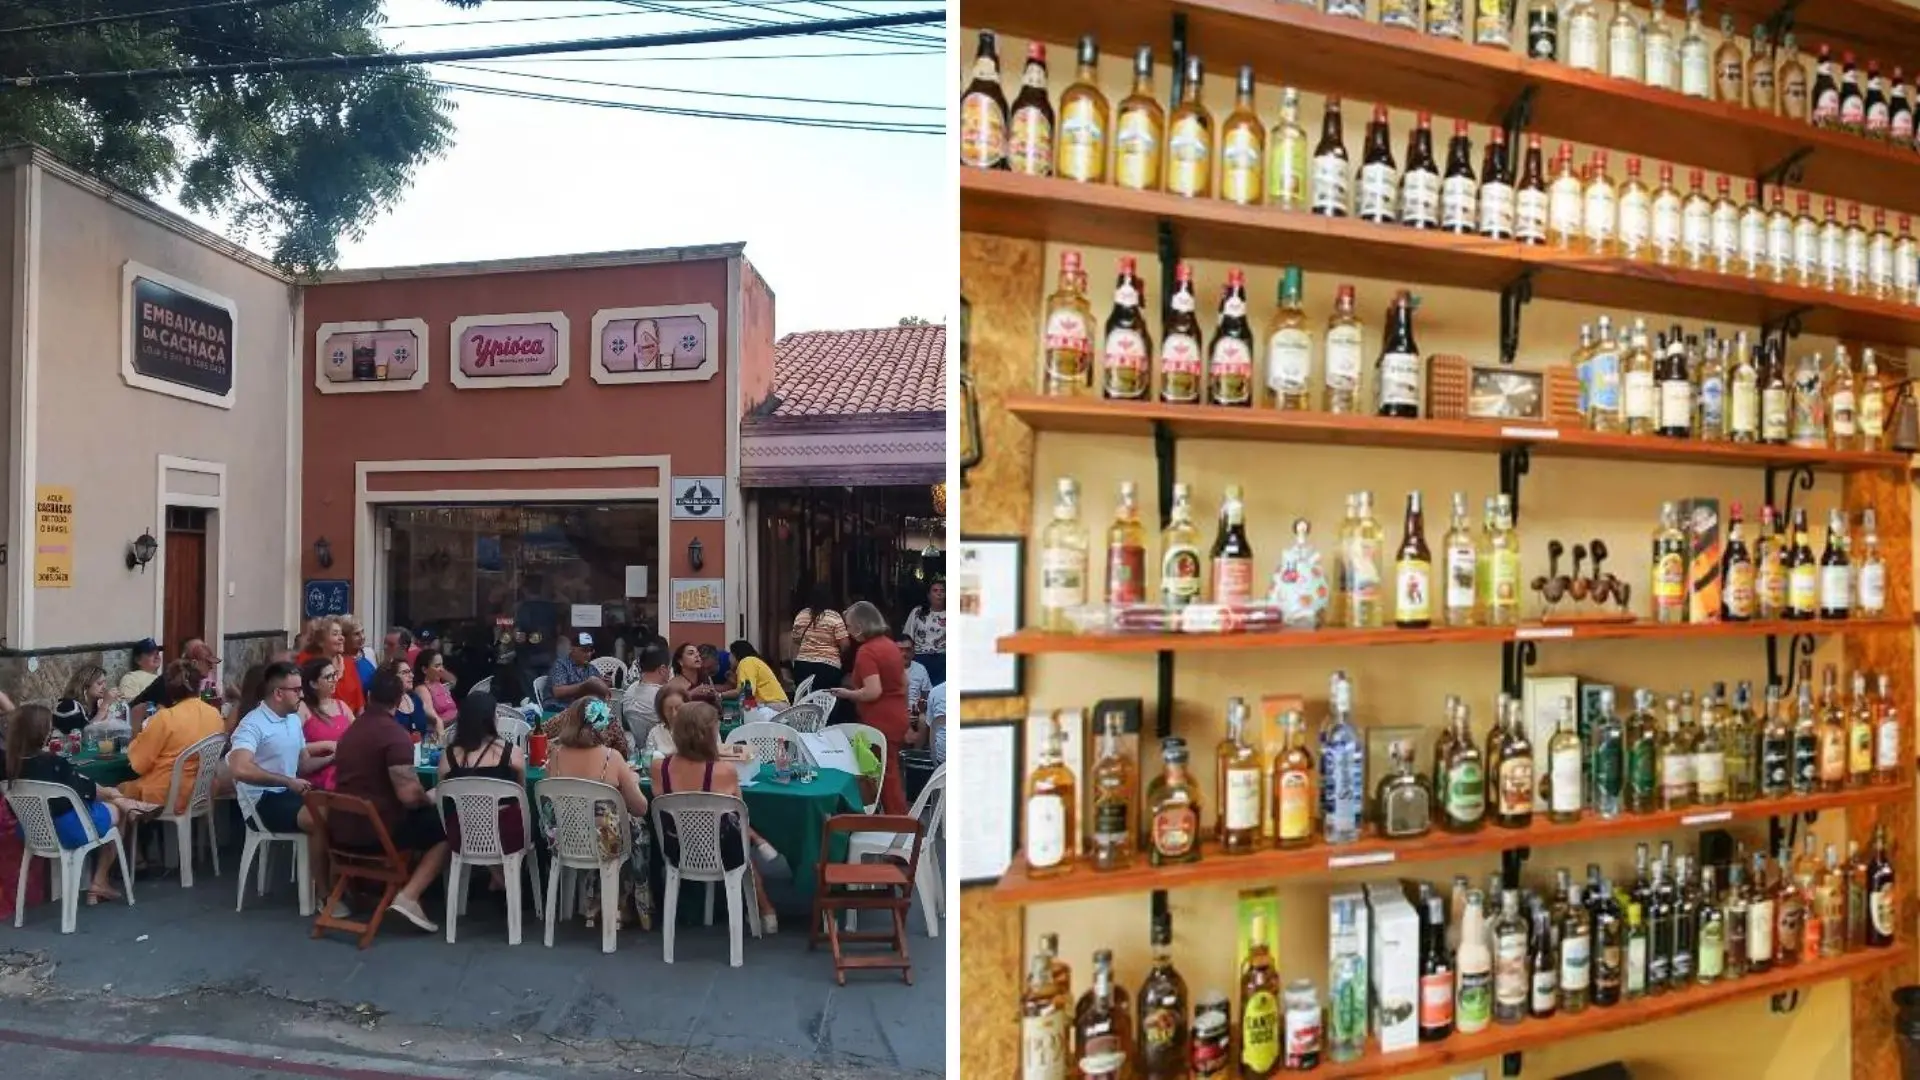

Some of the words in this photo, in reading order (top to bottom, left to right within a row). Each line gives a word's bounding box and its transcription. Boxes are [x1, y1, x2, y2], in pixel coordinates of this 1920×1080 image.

[143, 302, 226, 345] EMBAIXADA
[143, 325, 158, 342] DA
[160, 329, 226, 365] CACHAÇA
[470, 334, 545, 368] Ypióca
